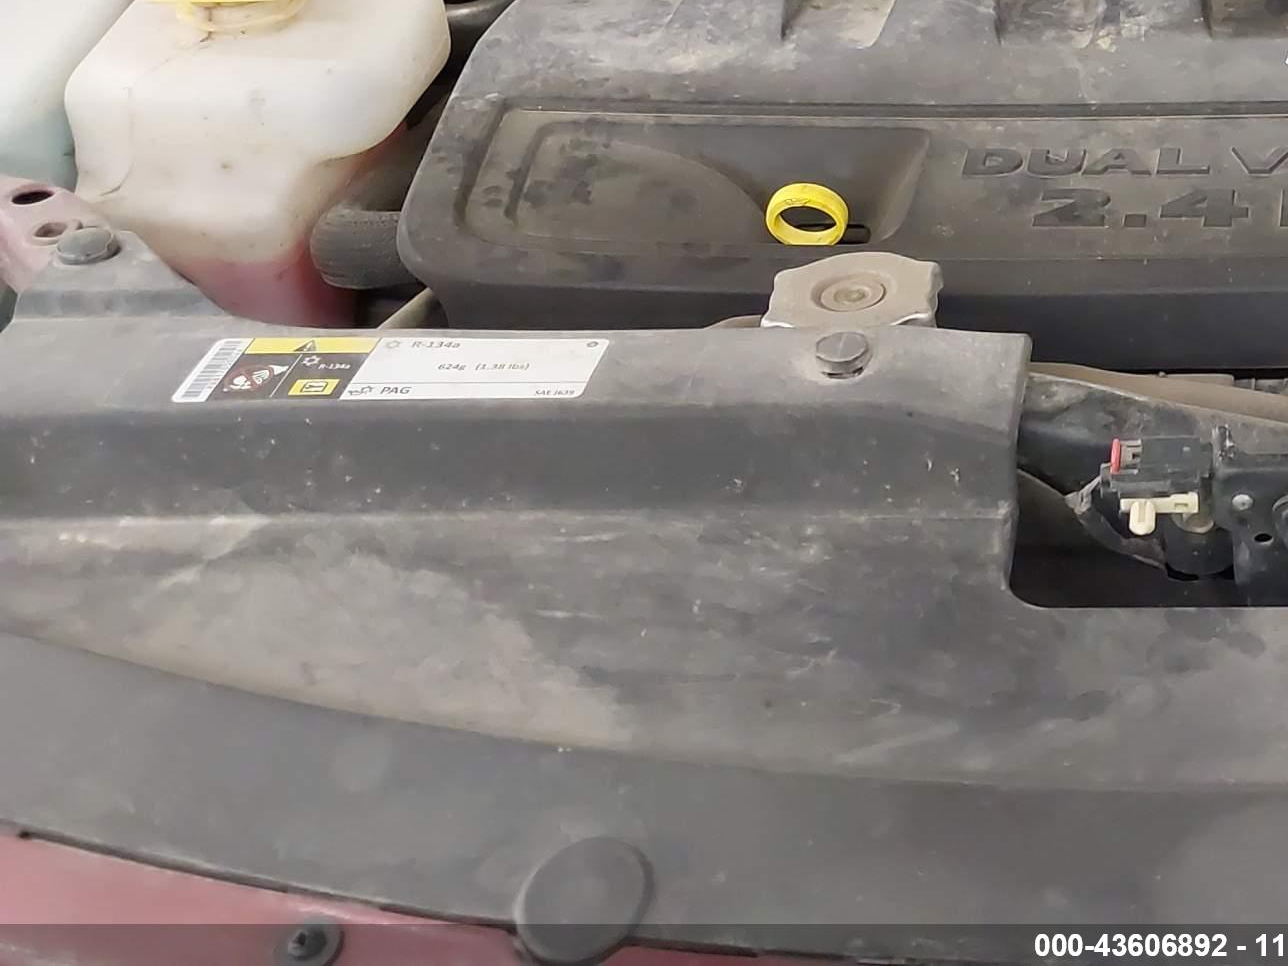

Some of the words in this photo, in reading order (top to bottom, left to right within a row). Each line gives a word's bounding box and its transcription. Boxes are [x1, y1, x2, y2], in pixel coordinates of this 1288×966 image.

[963, 147, 1211, 177] DUAL
[410, 340, 461, 349] R-134a
[437, 363, 467, 371] 624g
[380, 386, 412, 395] PAG
